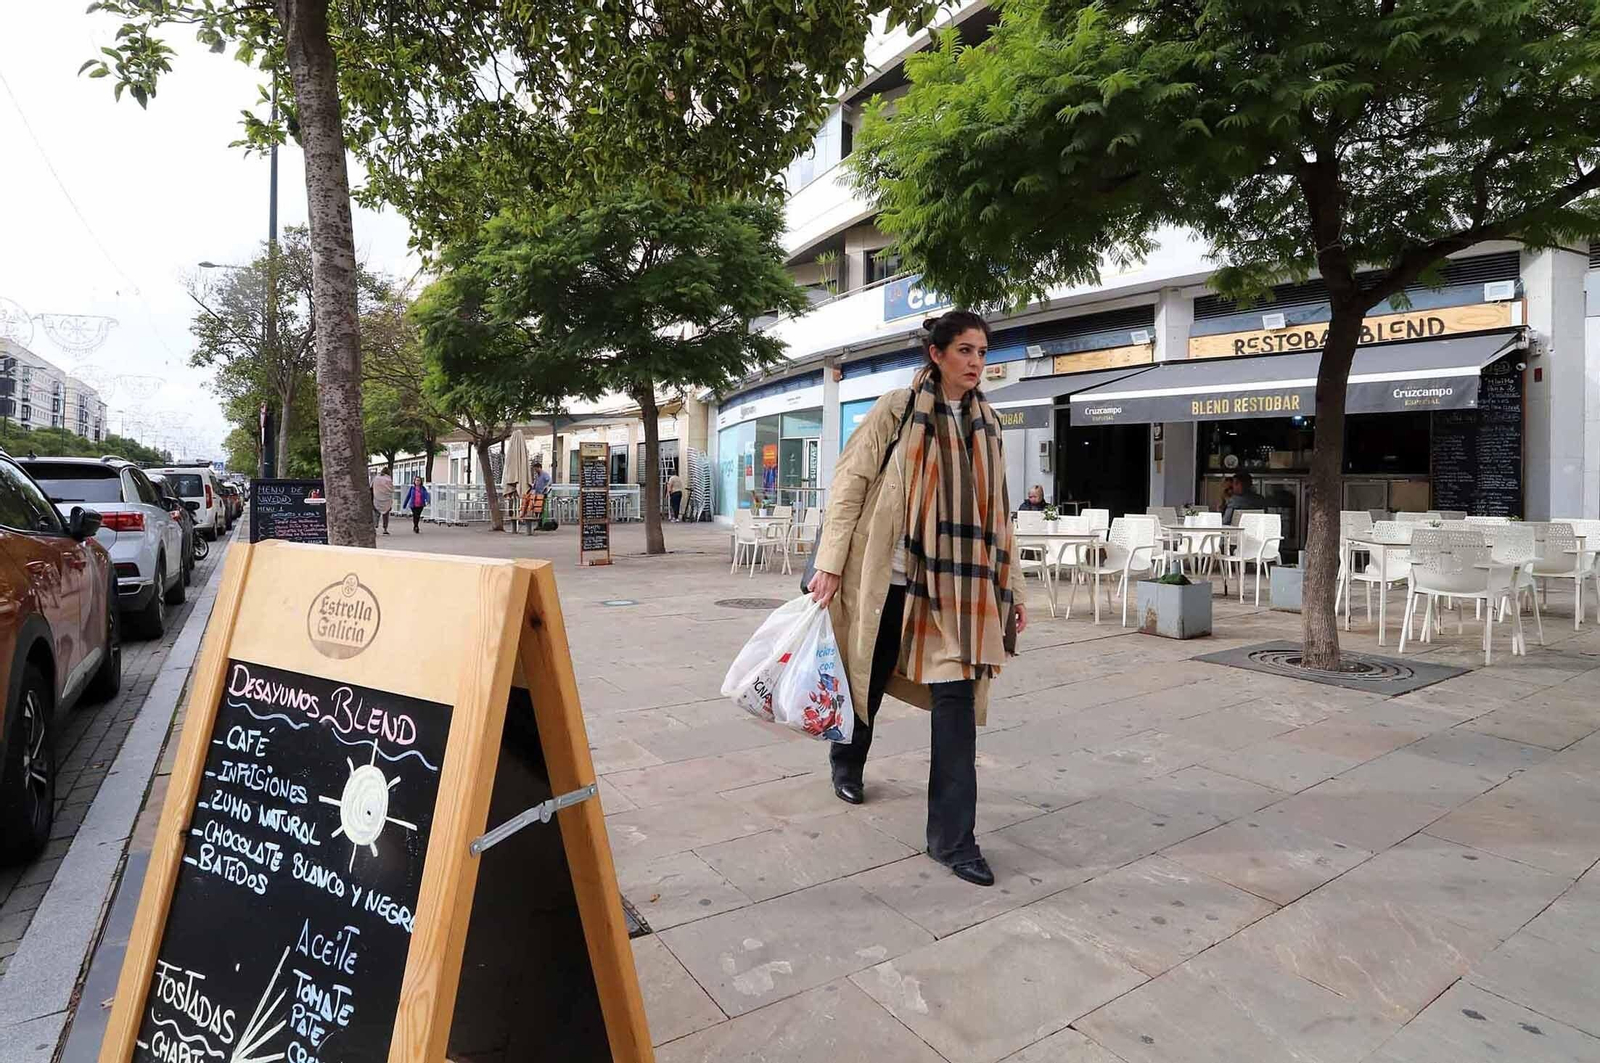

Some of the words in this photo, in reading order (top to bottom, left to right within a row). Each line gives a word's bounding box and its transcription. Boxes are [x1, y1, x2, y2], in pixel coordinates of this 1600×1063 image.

[1234, 329, 1329, 356] RESTOBA
[1359, 316, 1446, 345] BLEND
[1084, 407, 1122, 417] Cruzcampo
[1191, 399, 1229, 416] BLEND
[1233, 394, 1300, 414] RESTOBAR
[1393, 387, 1454, 398] Cruzcampo
[319, 595, 372, 621] Estrella
[318, 616, 364, 642] Galicia
[228, 664, 320, 718] DESAYUNOS
[319, 686, 416, 745] BLEND
[259, 804, 321, 846] NATURAL
[293, 852, 345, 897] BLANCO
[351, 884, 362, 907] Y
[293, 968, 354, 1027] TOMATE
[290, 1003, 325, 1047] PATE
